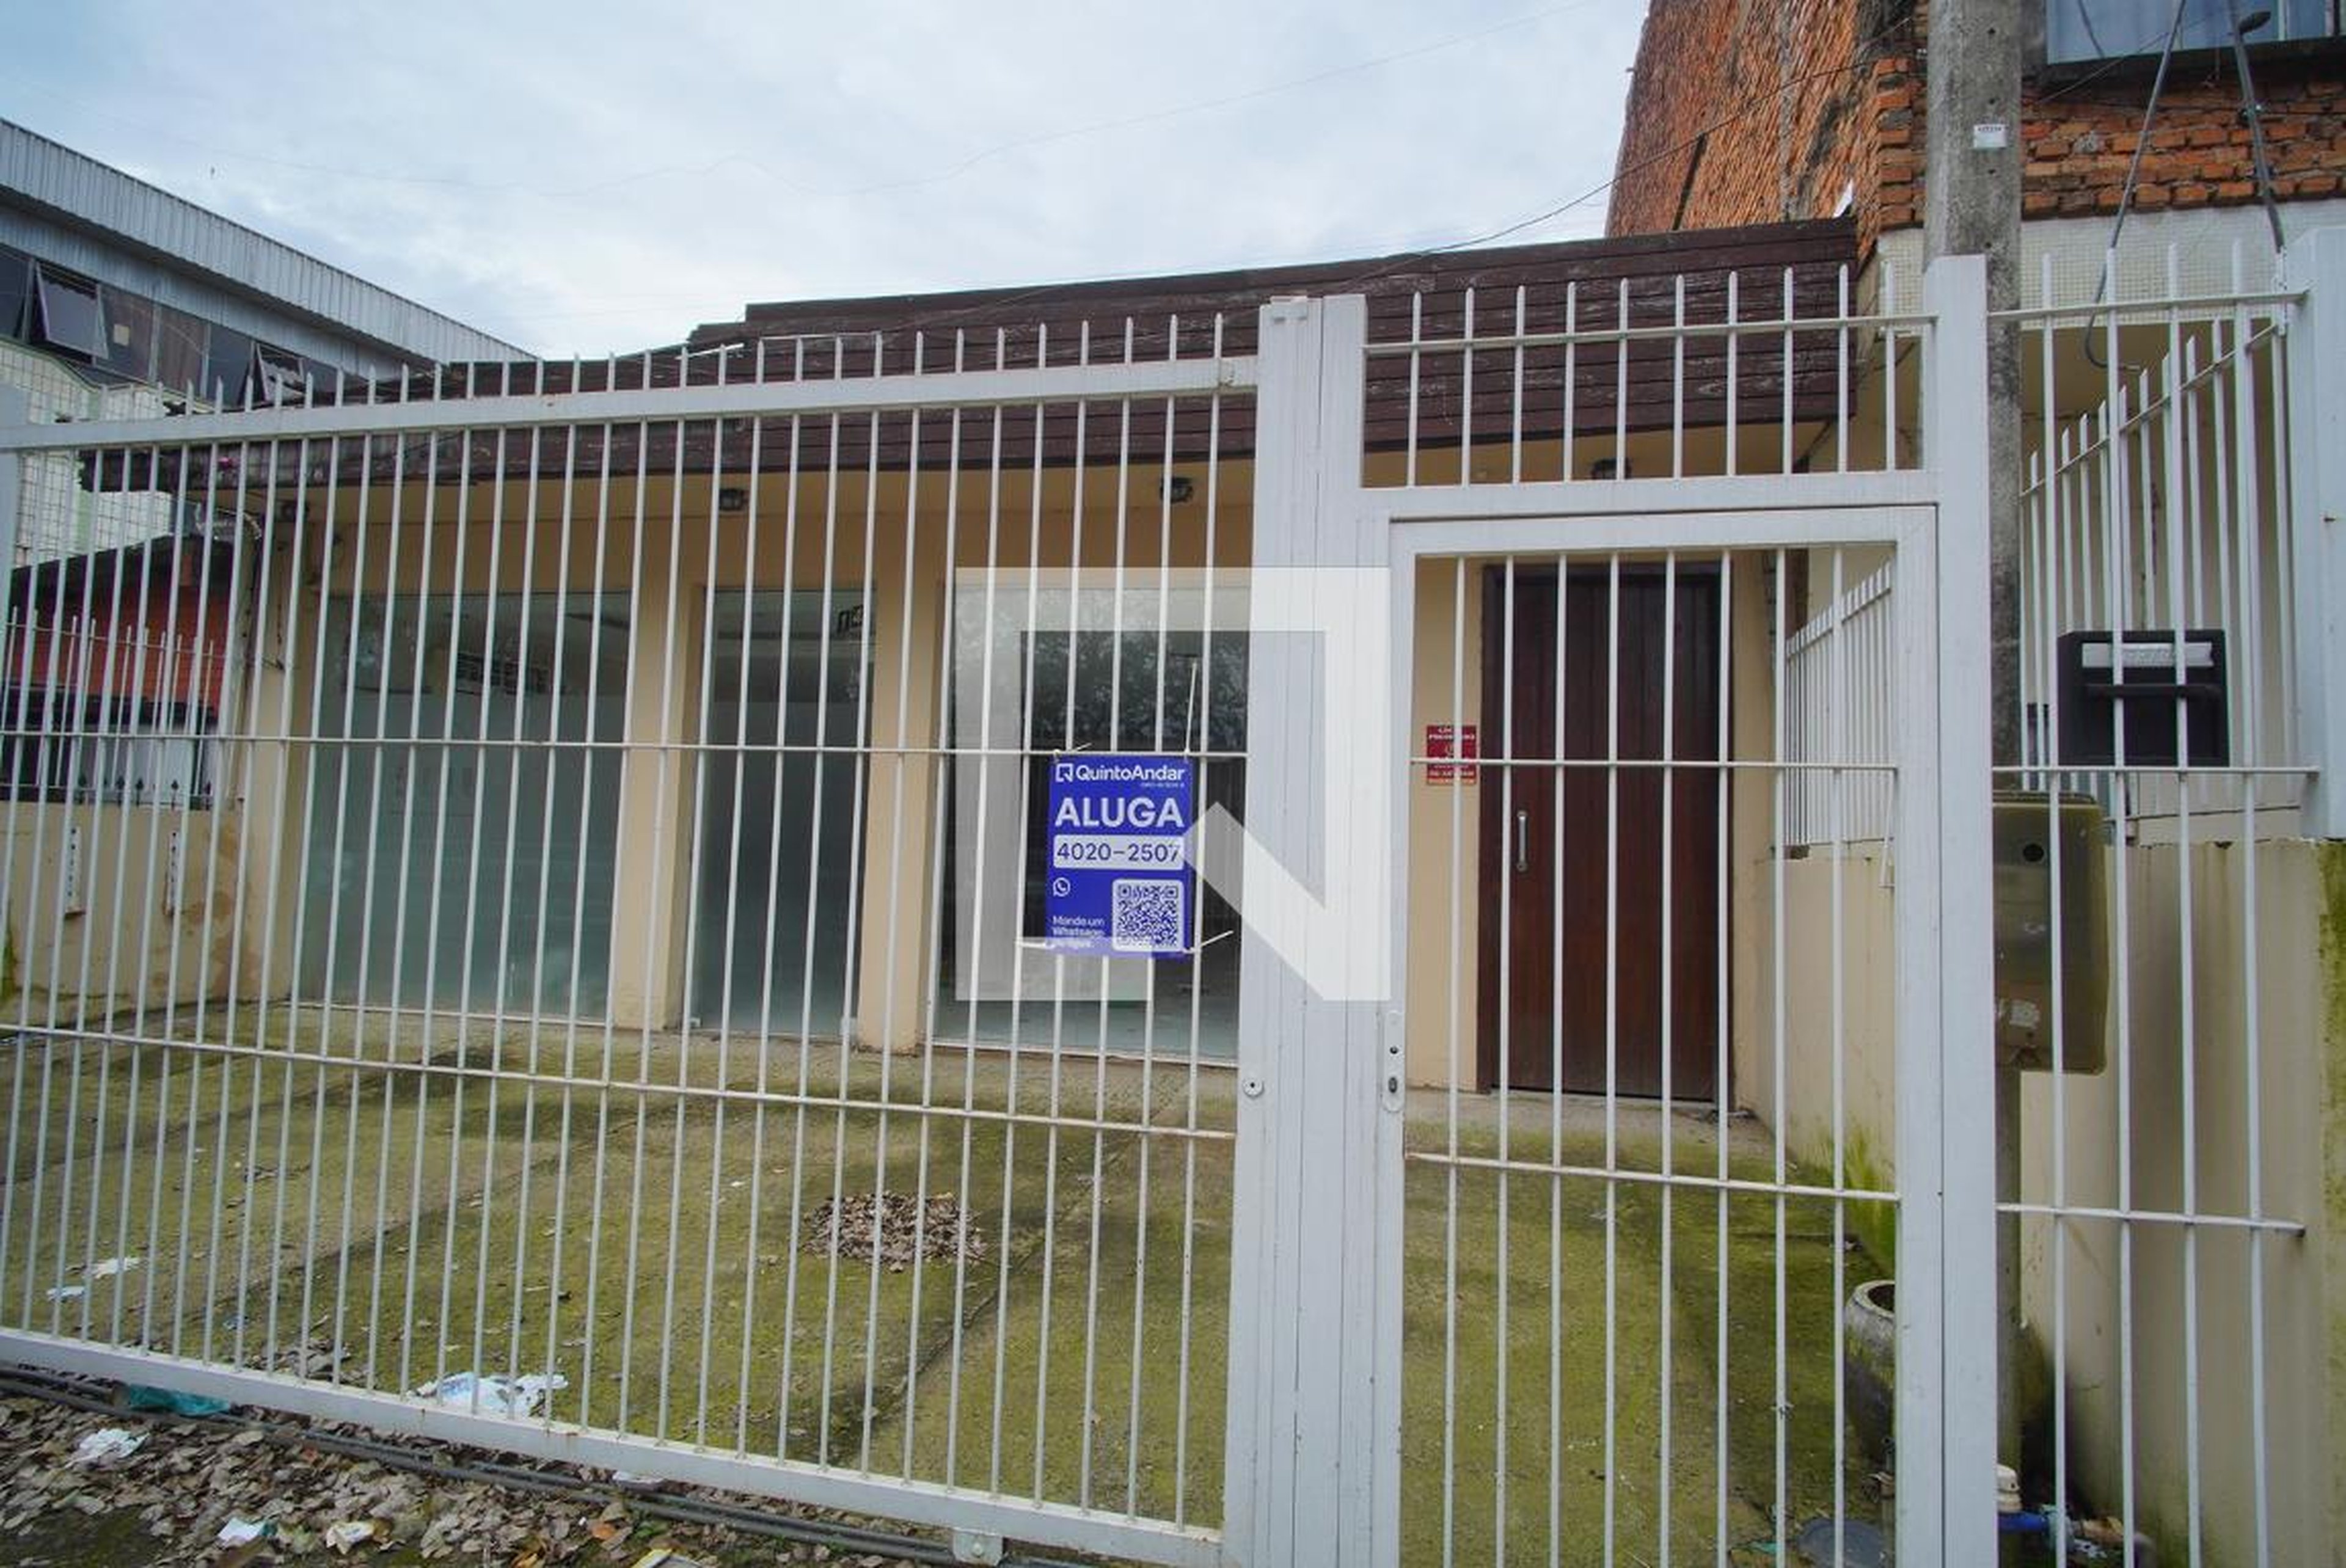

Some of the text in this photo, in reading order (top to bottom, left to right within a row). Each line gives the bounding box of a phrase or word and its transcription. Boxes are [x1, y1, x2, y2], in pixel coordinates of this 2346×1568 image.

[1075, 765, 1185, 781] QuintoAndar
[1054, 797, 1185, 828] ALUGA
[1057, 842, 1180, 862] 4020-2507
